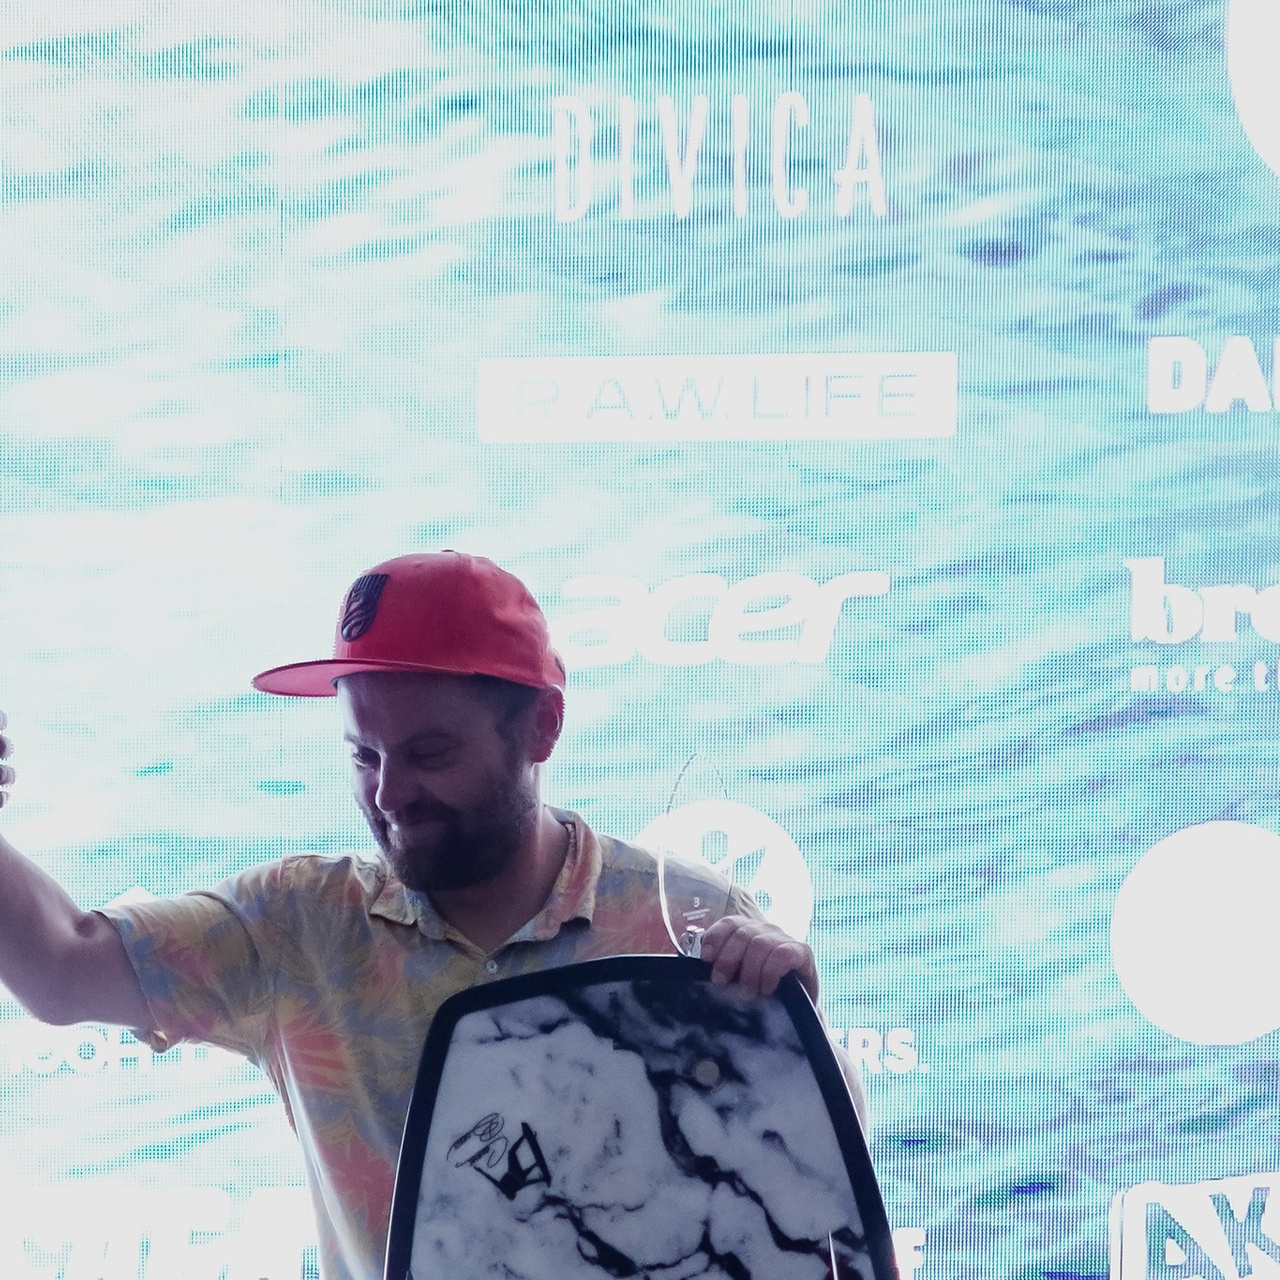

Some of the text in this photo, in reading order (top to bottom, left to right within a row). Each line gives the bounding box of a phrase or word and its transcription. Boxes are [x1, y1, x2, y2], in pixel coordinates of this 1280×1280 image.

[553, 94, 889, 222] DIVICA
[515, 370, 921, 424] R.A.W.LIFE
[1148, 336, 1280, 412] DA
[548, 571, 890, 668] acer
